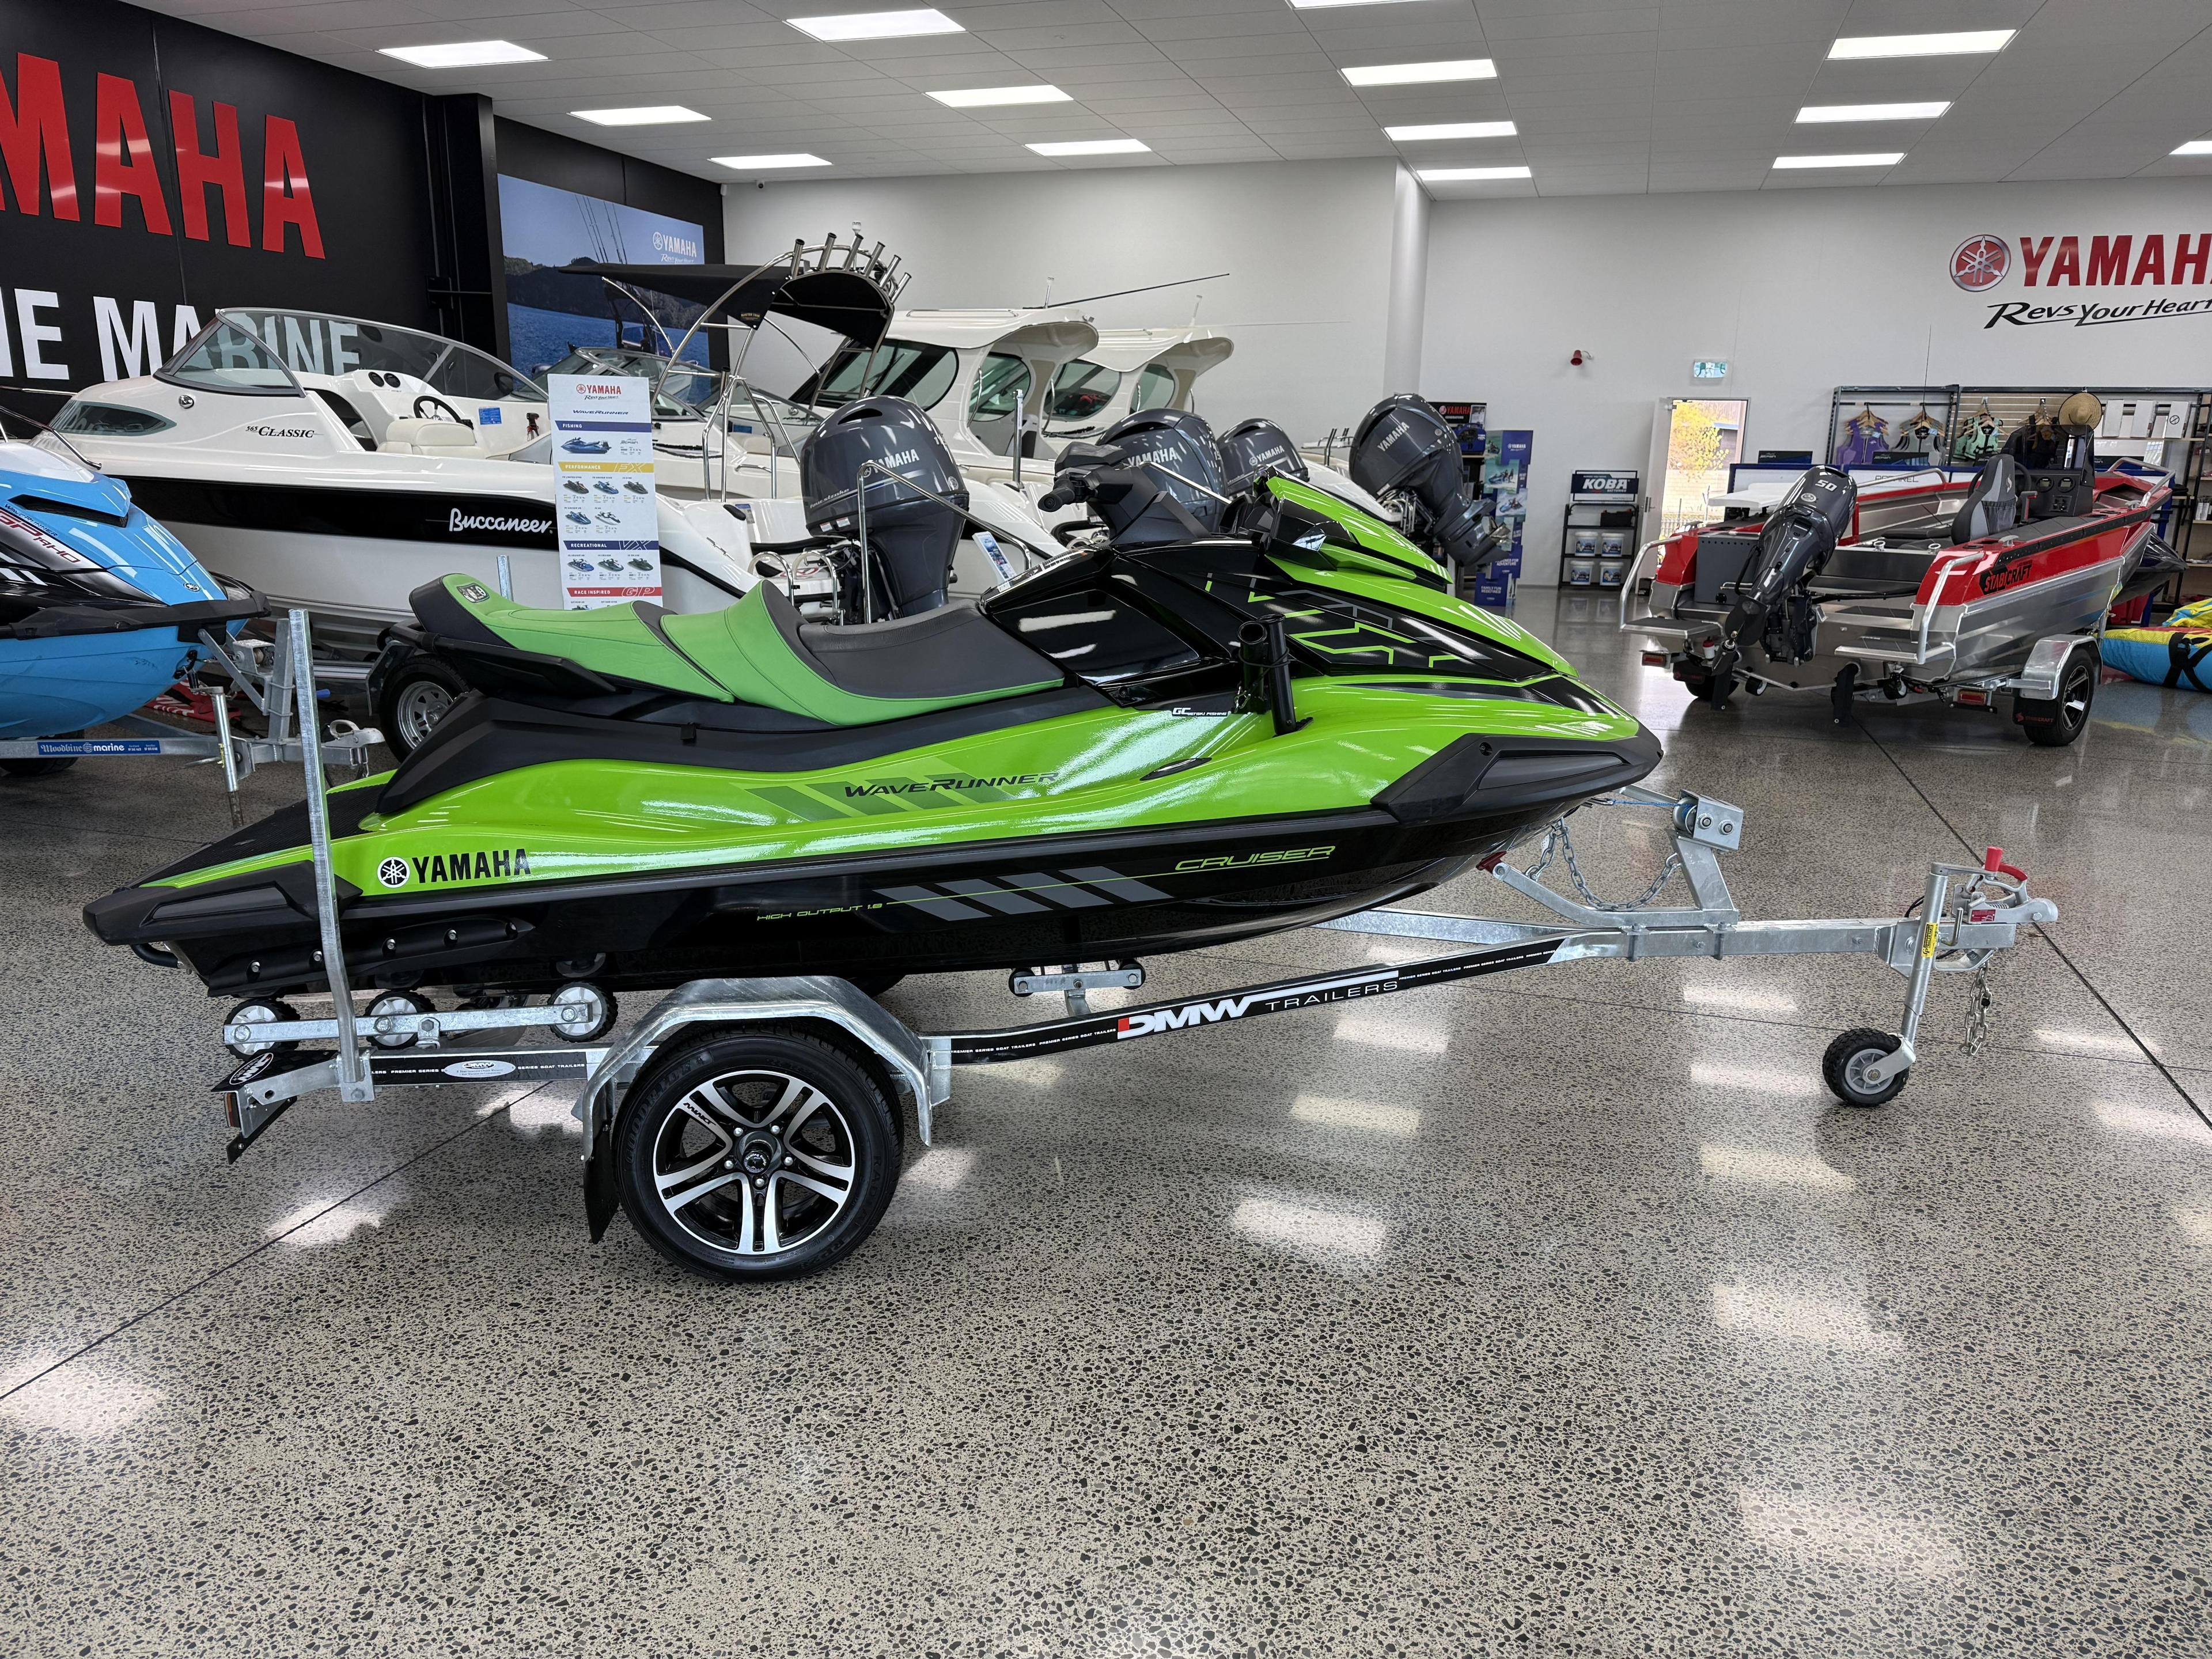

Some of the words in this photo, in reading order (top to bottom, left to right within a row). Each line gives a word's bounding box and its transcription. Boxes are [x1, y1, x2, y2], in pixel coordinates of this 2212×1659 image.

[663, 234, 696, 257] YAMAHA
[2020, 233, 2212, 287] YAMAH
[1983, 301, 2078, 329] Revs
[2074, 303, 2145, 327] Your
[586, 385, 622, 395] YAMAHA
[1447, 406, 1471, 414] YAMAHA
[258, 426, 315, 438] CLASSIC
[1377, 421, 1410, 452] YAMAHA
[1127, 447, 1177, 466] YAMAHA
[1256, 445, 1285, 461] YAMAHA
[1582, 478, 1627, 490] KOBA
[1815, 479, 1838, 492] 50
[449, 507, 552, 533] Buccaneer
[1984, 564, 2032, 592] STABICRAFT
[40, 744, 83, 753] Woodbine
[93, 743, 125, 751] marine
[844, 772, 1061, 797] WAVERUNNER
[411, 849, 531, 883] YAMAHA
[1175, 846, 1336, 870] CRUISER
[797, 905, 863, 916] OUTPUT
[1266, 981, 1398, 1011] TRAILERS
